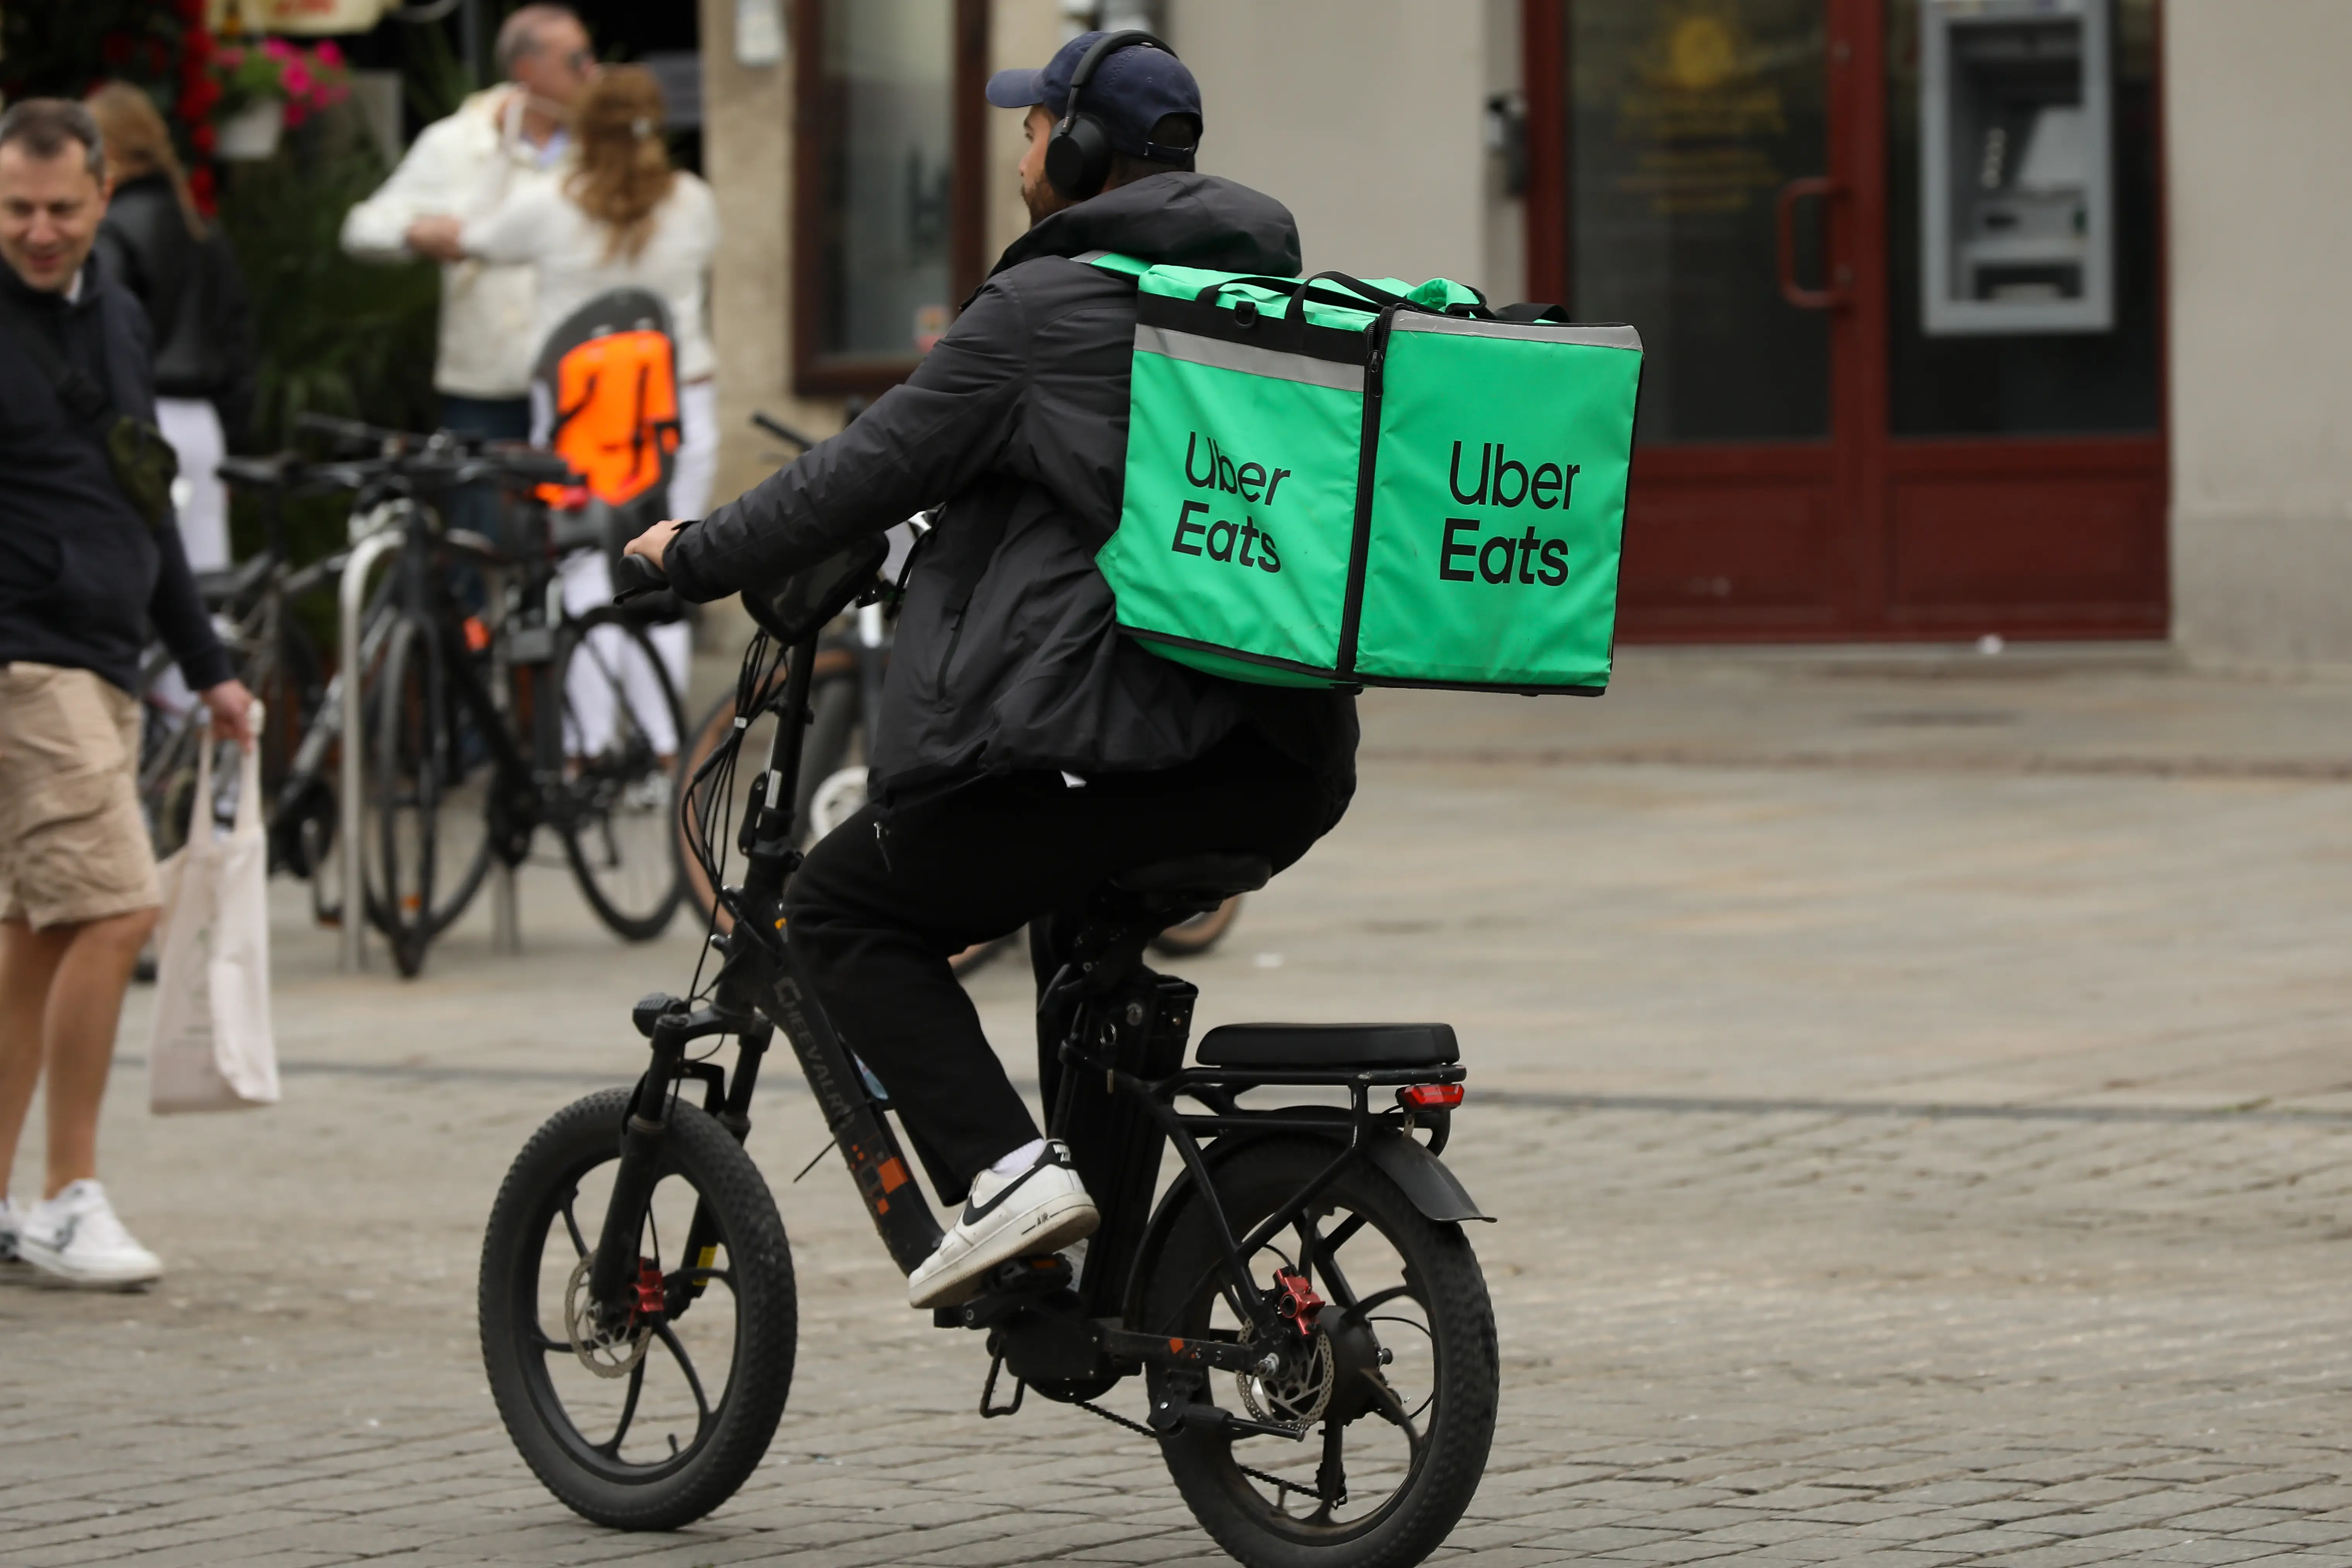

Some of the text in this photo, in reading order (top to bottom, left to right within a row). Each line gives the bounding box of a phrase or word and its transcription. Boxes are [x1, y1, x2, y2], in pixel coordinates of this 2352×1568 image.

[1186, 431, 1291, 506] Uber
[1449, 440, 1580, 510] Uber
[1172, 500, 1281, 573] Eats
[1440, 518, 1568, 587] Eats
